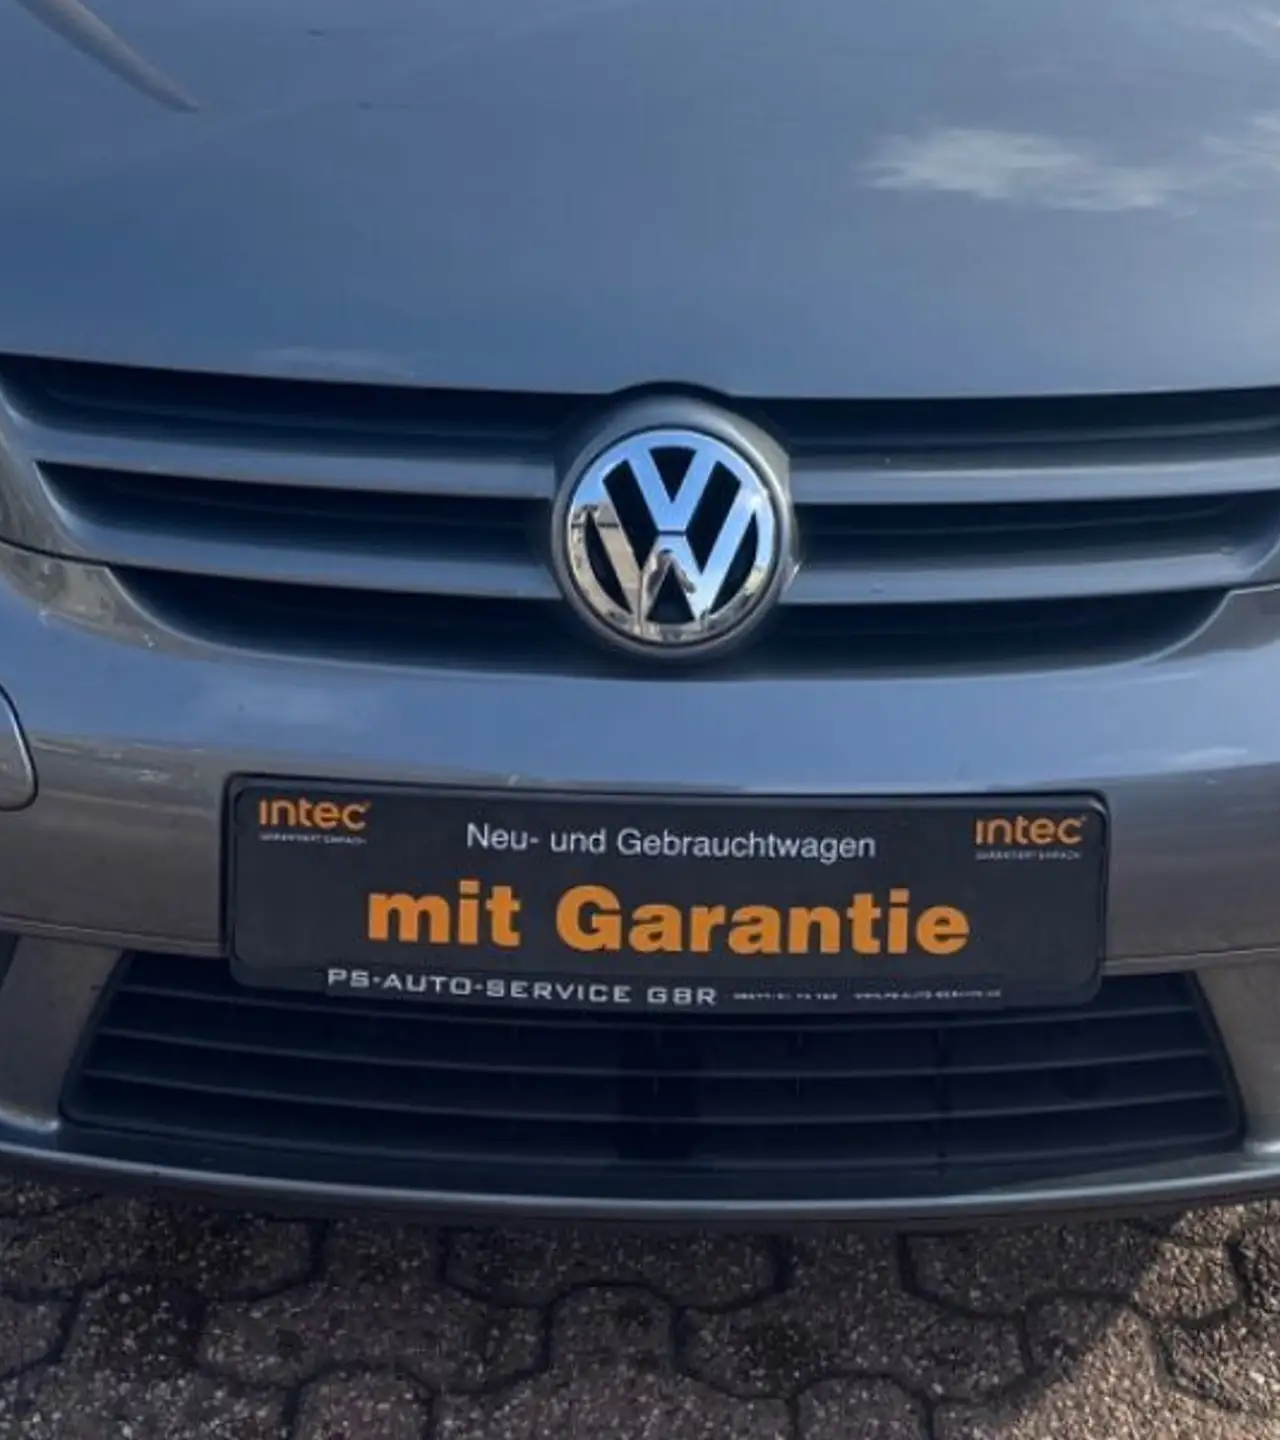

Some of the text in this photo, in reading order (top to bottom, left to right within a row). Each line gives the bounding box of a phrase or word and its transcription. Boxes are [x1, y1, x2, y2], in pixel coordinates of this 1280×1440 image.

[260, 796, 368, 831] intec
[975, 815, 1083, 845] intec
[466, 822, 877, 865] Neu- und Gebrauchtwagen
[368, 879, 971, 955] mit Garantie
[327, 968, 719, 1006] PS-AUTO-SERVICE GBR
